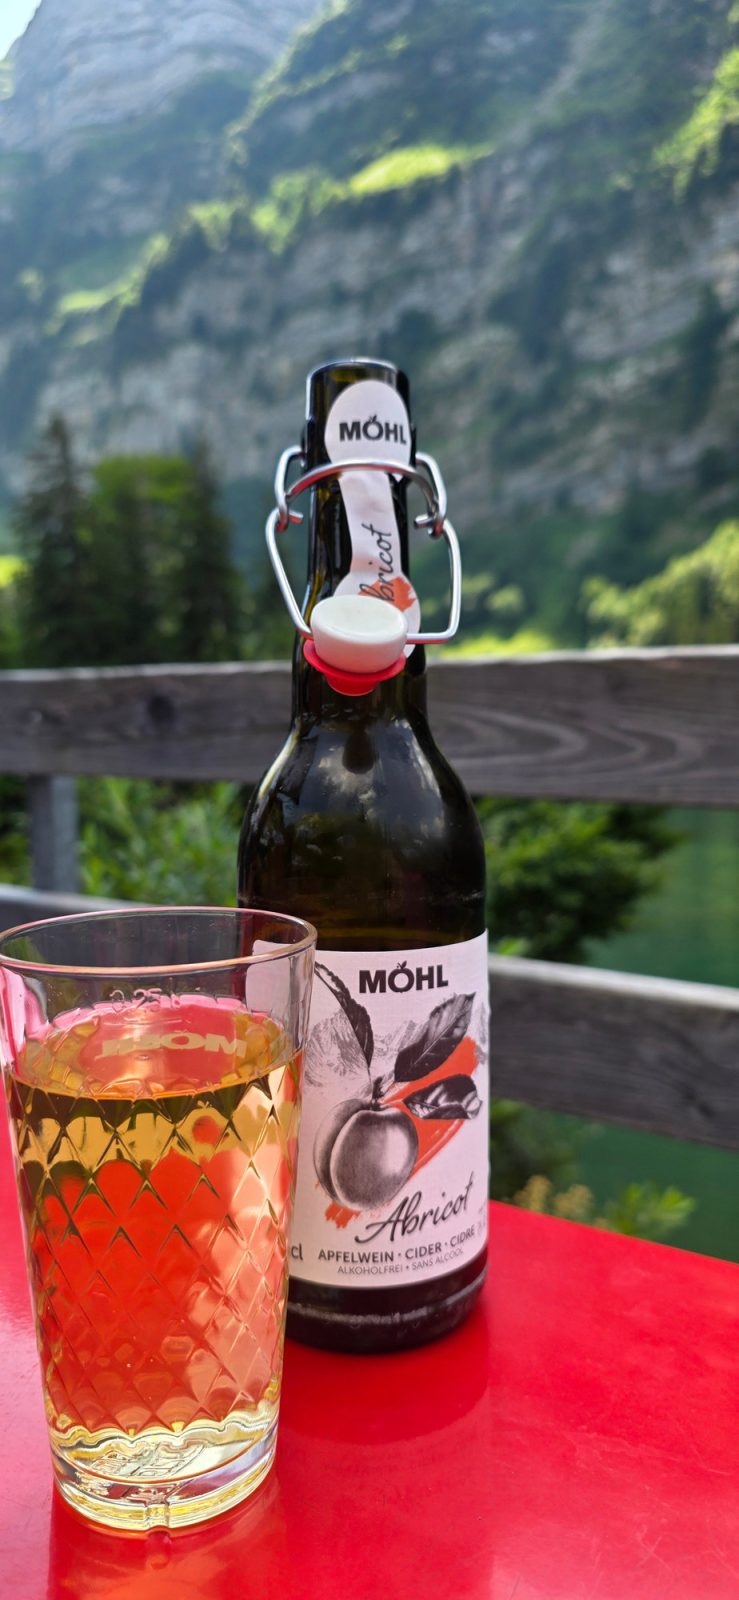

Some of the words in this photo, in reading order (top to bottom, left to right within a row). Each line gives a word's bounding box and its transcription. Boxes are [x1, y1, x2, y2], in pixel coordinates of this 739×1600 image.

[339, 415, 406, 445] MÖHL
[359, 523, 395, 601] bricot
[359, 961, 449, 993] MÖHL
[354, 1171, 474, 1244] Abricot
[291, 1243, 303, 1261] cl
[318, 1248, 394, 1264] APFELWEIN
[404, 1242, 442, 1260] CIDER
[450, 1225, 475, 1247] CIDRE
[337, 1264, 403, 1275] ALKOHOLFREI
[412, 1258, 434, 1271] SANS
[435, 1247, 463, 1265] ALCOOL
